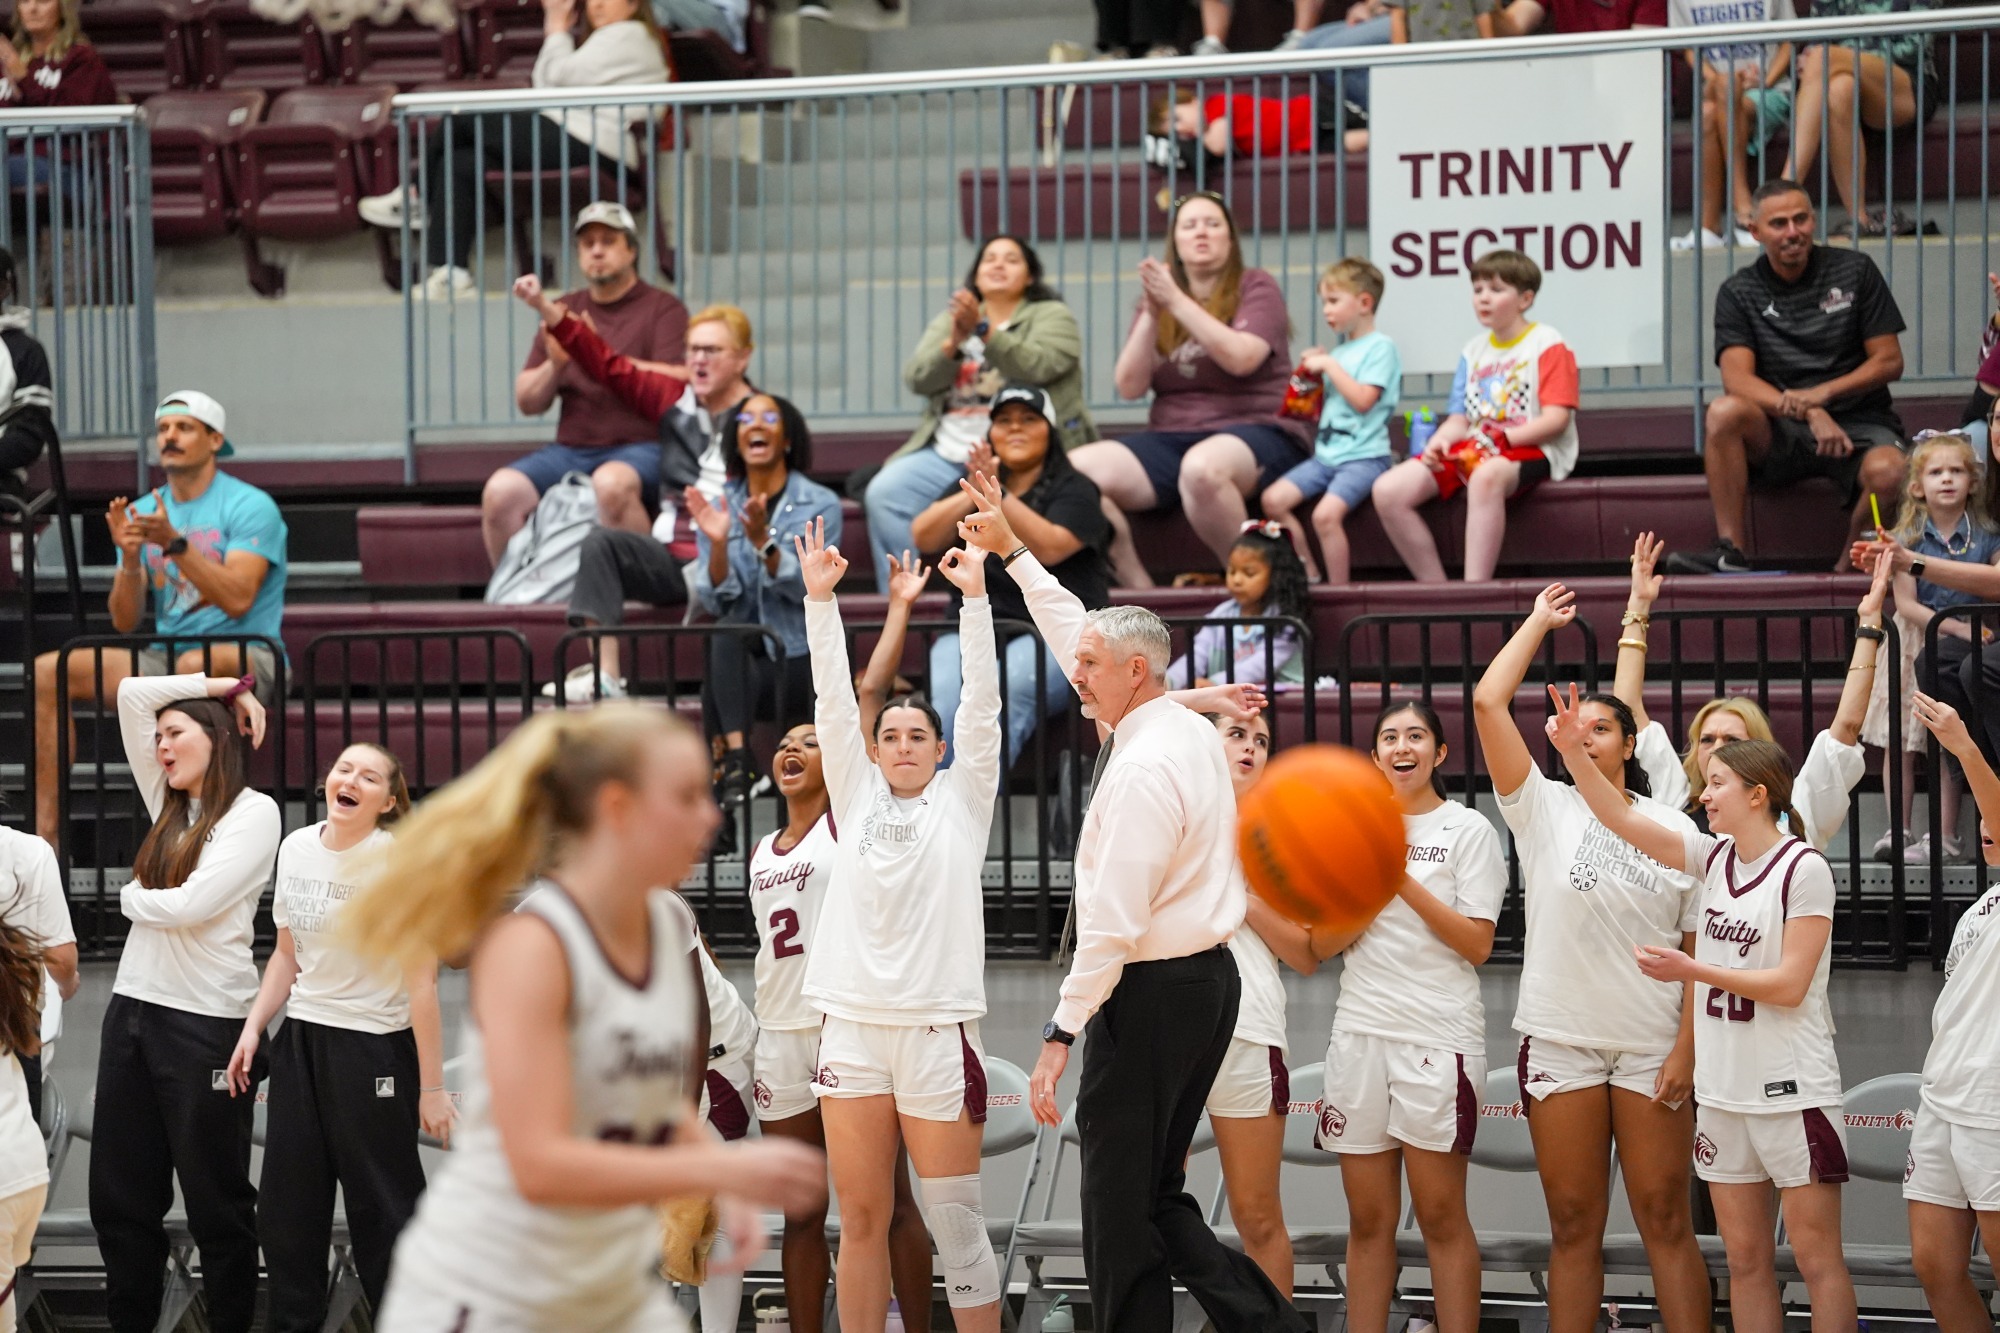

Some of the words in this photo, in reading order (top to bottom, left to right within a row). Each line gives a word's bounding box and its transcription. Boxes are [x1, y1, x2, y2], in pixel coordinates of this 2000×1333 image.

[1398, 141, 1634, 199] TRINITY
[1390, 220, 1642, 278] SECTION
[1405, 844, 1448, 863] TIGERS
[1574, 845, 1658, 894] BASKETBALL
[326, 881, 357, 901] TIGER
[750, 861, 815, 899] Trinity
[769, 907, 805, 960] 2
[1705, 907, 1762, 957] Trinity
[986, 1094, 1022, 1107] IGERS
[1843, 1113, 1896, 1128] RINITY
